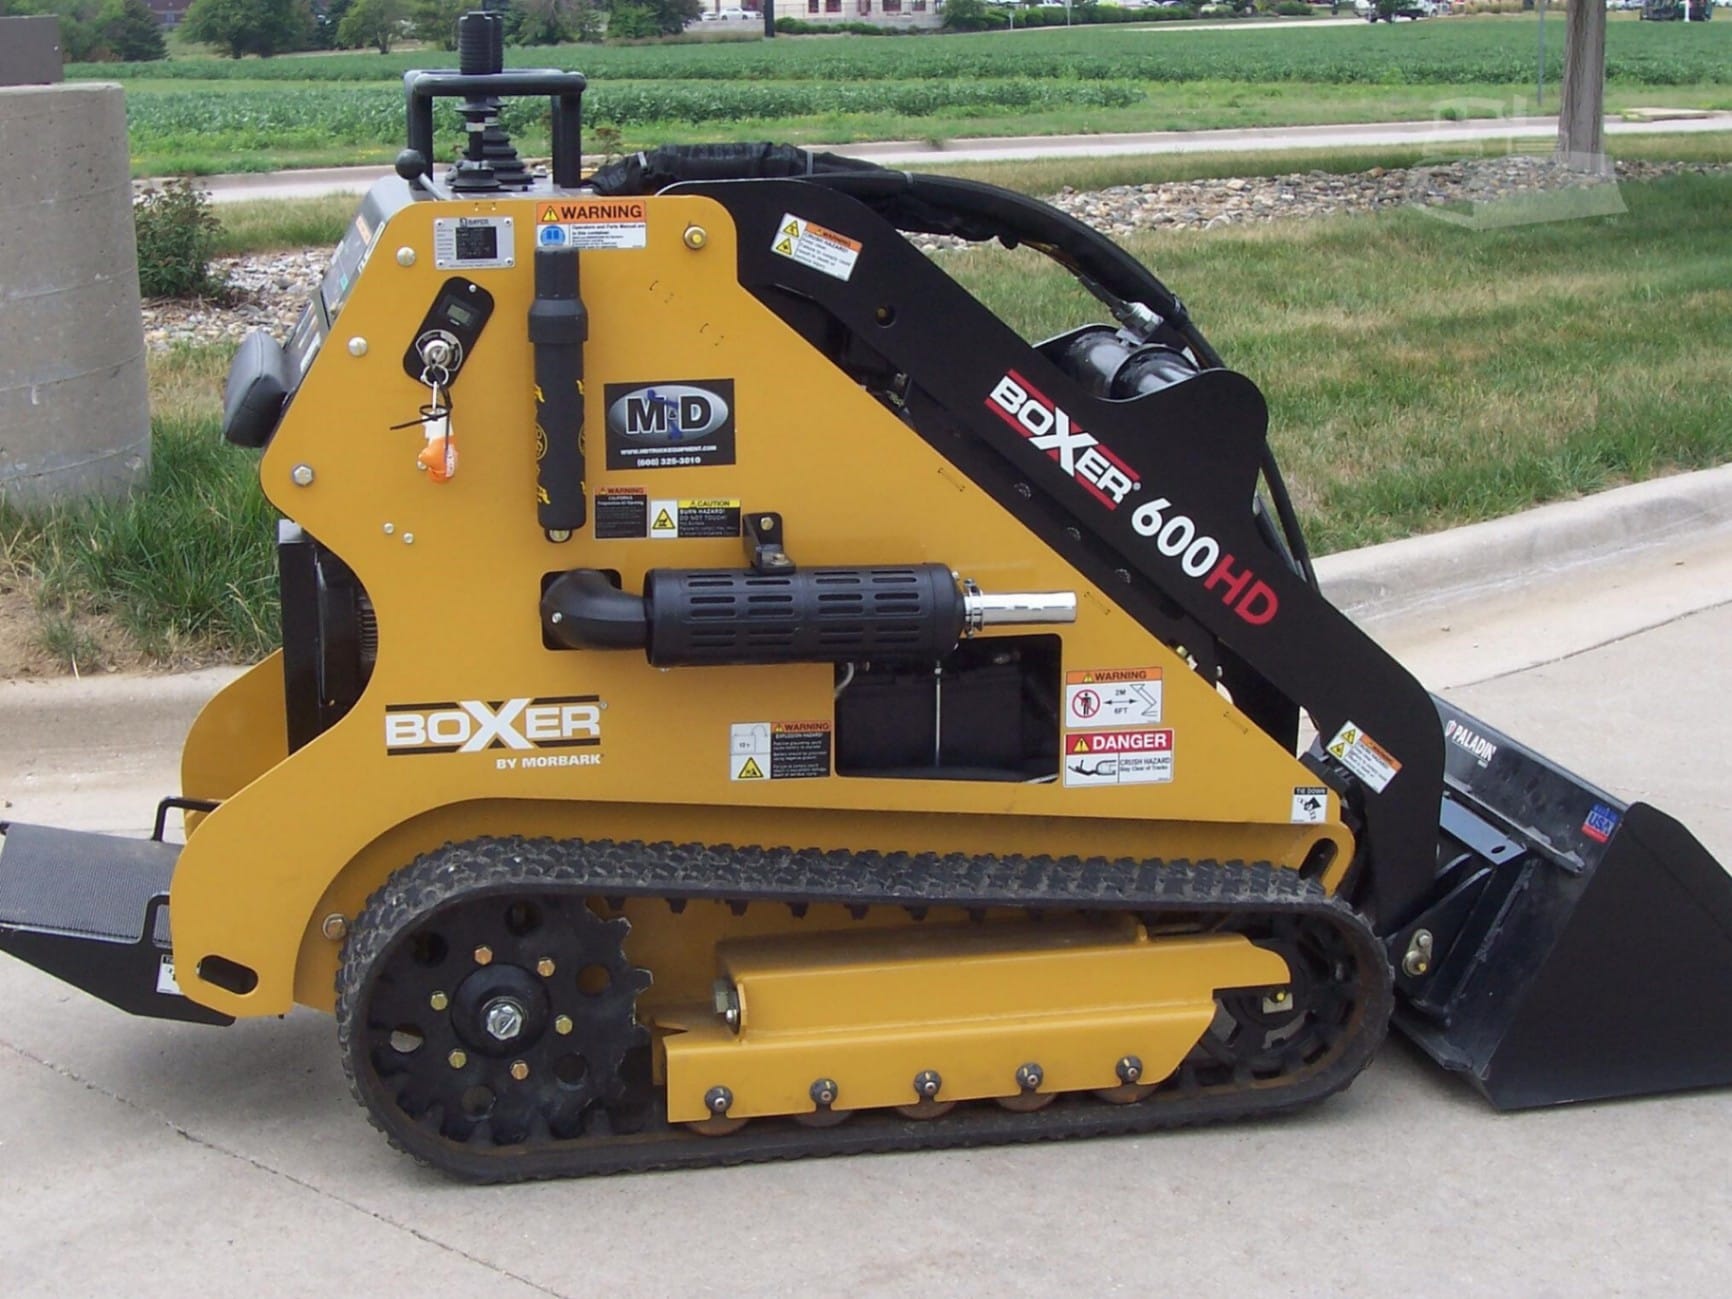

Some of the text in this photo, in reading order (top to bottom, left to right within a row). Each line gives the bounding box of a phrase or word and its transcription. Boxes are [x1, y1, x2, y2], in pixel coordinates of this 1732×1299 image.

[561, 205, 643, 219] WARNING
[990, 375, 1134, 504] BOXER
[1095, 670, 1147, 681] WARNING
[385, 698, 600, 752] BOXER
[785, 722, 829, 731] WARNING
[1093, 733, 1167, 750] DANGER
[1451, 725, 1496, 762] PALADIN
[496, 754, 601, 769] BY MORBARK
